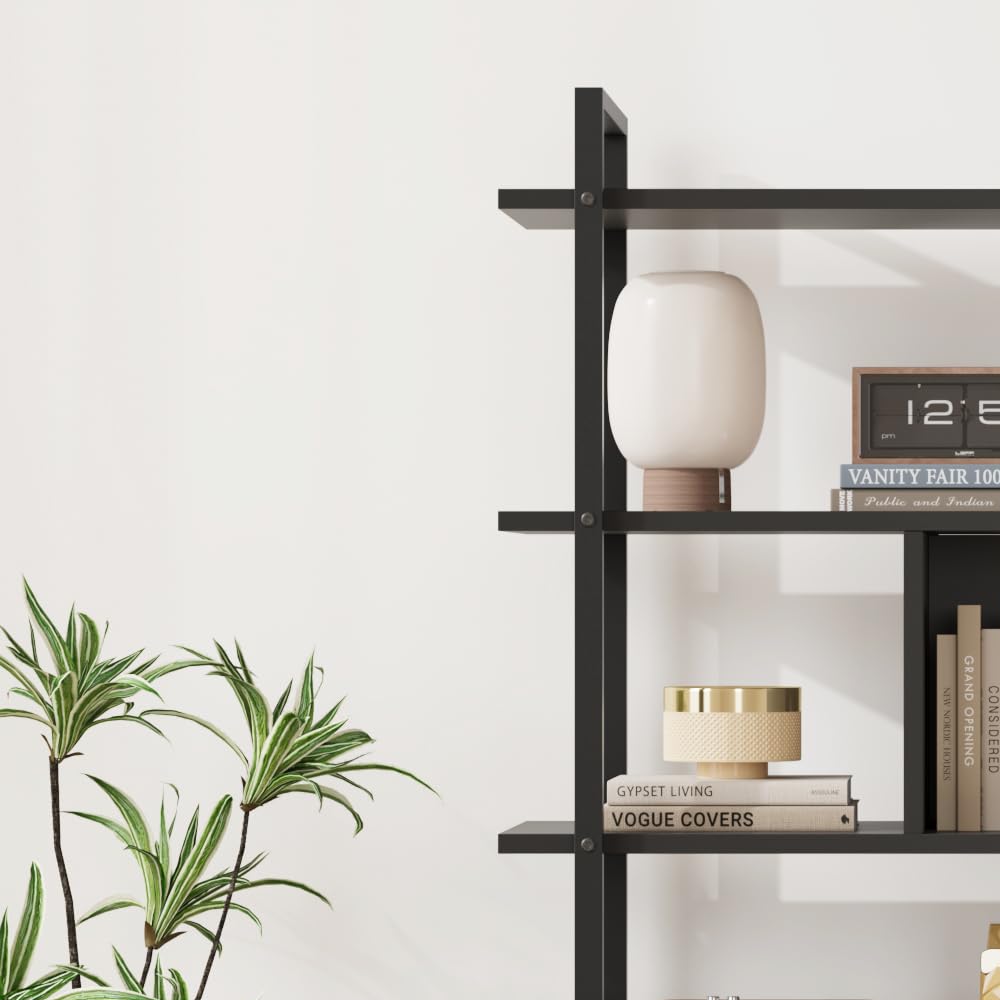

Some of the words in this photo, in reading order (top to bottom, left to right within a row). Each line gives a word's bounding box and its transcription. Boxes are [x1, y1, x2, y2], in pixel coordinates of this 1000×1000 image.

[907, 399, 954, 425] 12
[848, 468, 920, 485] VANITY
[926, 468, 969, 485] FAIR
[864, 496, 907, 507] Public
[912, 496, 941, 507] and
[945, 496, 995, 507] Indian
[964, 655, 975, 701] GRAND
[964, 706, 975, 767] OPENING
[988, 685, 1000, 774] CONSIDERED
[617, 785, 666, 797] GYPSET
[670, 785, 713, 797] LIVING
[611, 812, 674, 827] VOGUE
[680, 812, 754, 827] COVERS
